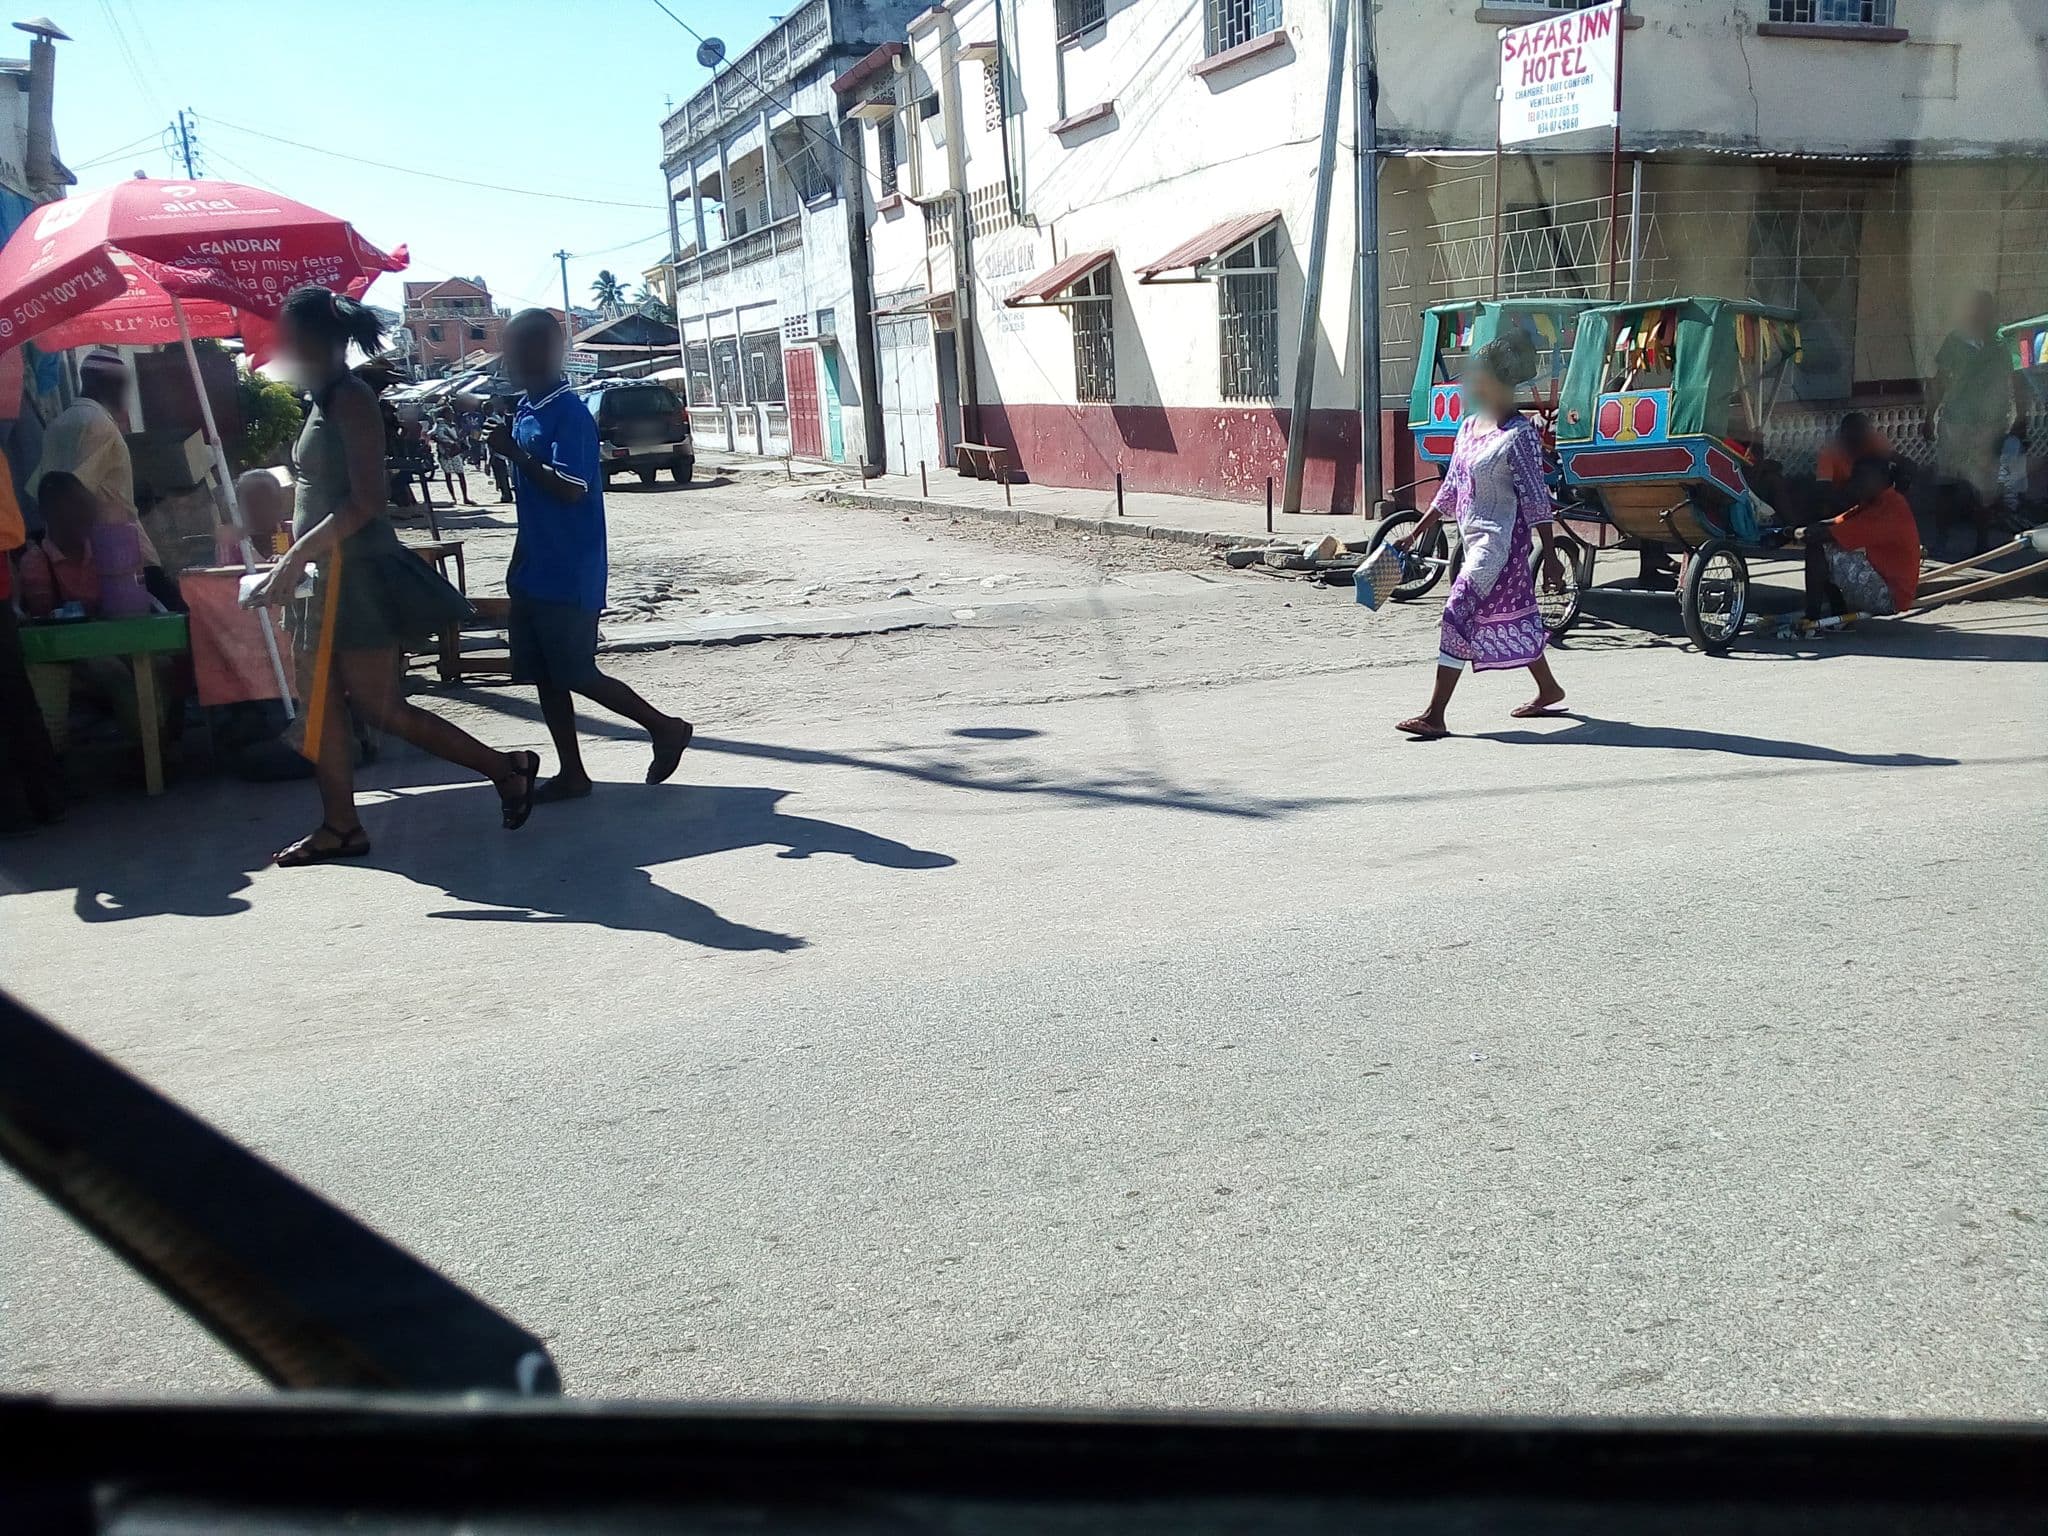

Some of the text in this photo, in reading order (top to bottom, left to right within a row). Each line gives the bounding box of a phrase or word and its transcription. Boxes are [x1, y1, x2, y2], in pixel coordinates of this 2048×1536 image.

[1505, 6, 1613, 62] SAFAR INN
[1521, 46, 1587, 87] HOTEL
[1515, 75, 1594, 100] CHAMBRE TOUT CONFORT
[161, 199, 239, 212] airtel
[231, 259, 257, 273] tsy
[262, 257, 298, 272] misy
[302, 255, 344, 269] fetra
[304, 265, 338, 278] 100
[0, 318, 13, 337] @
